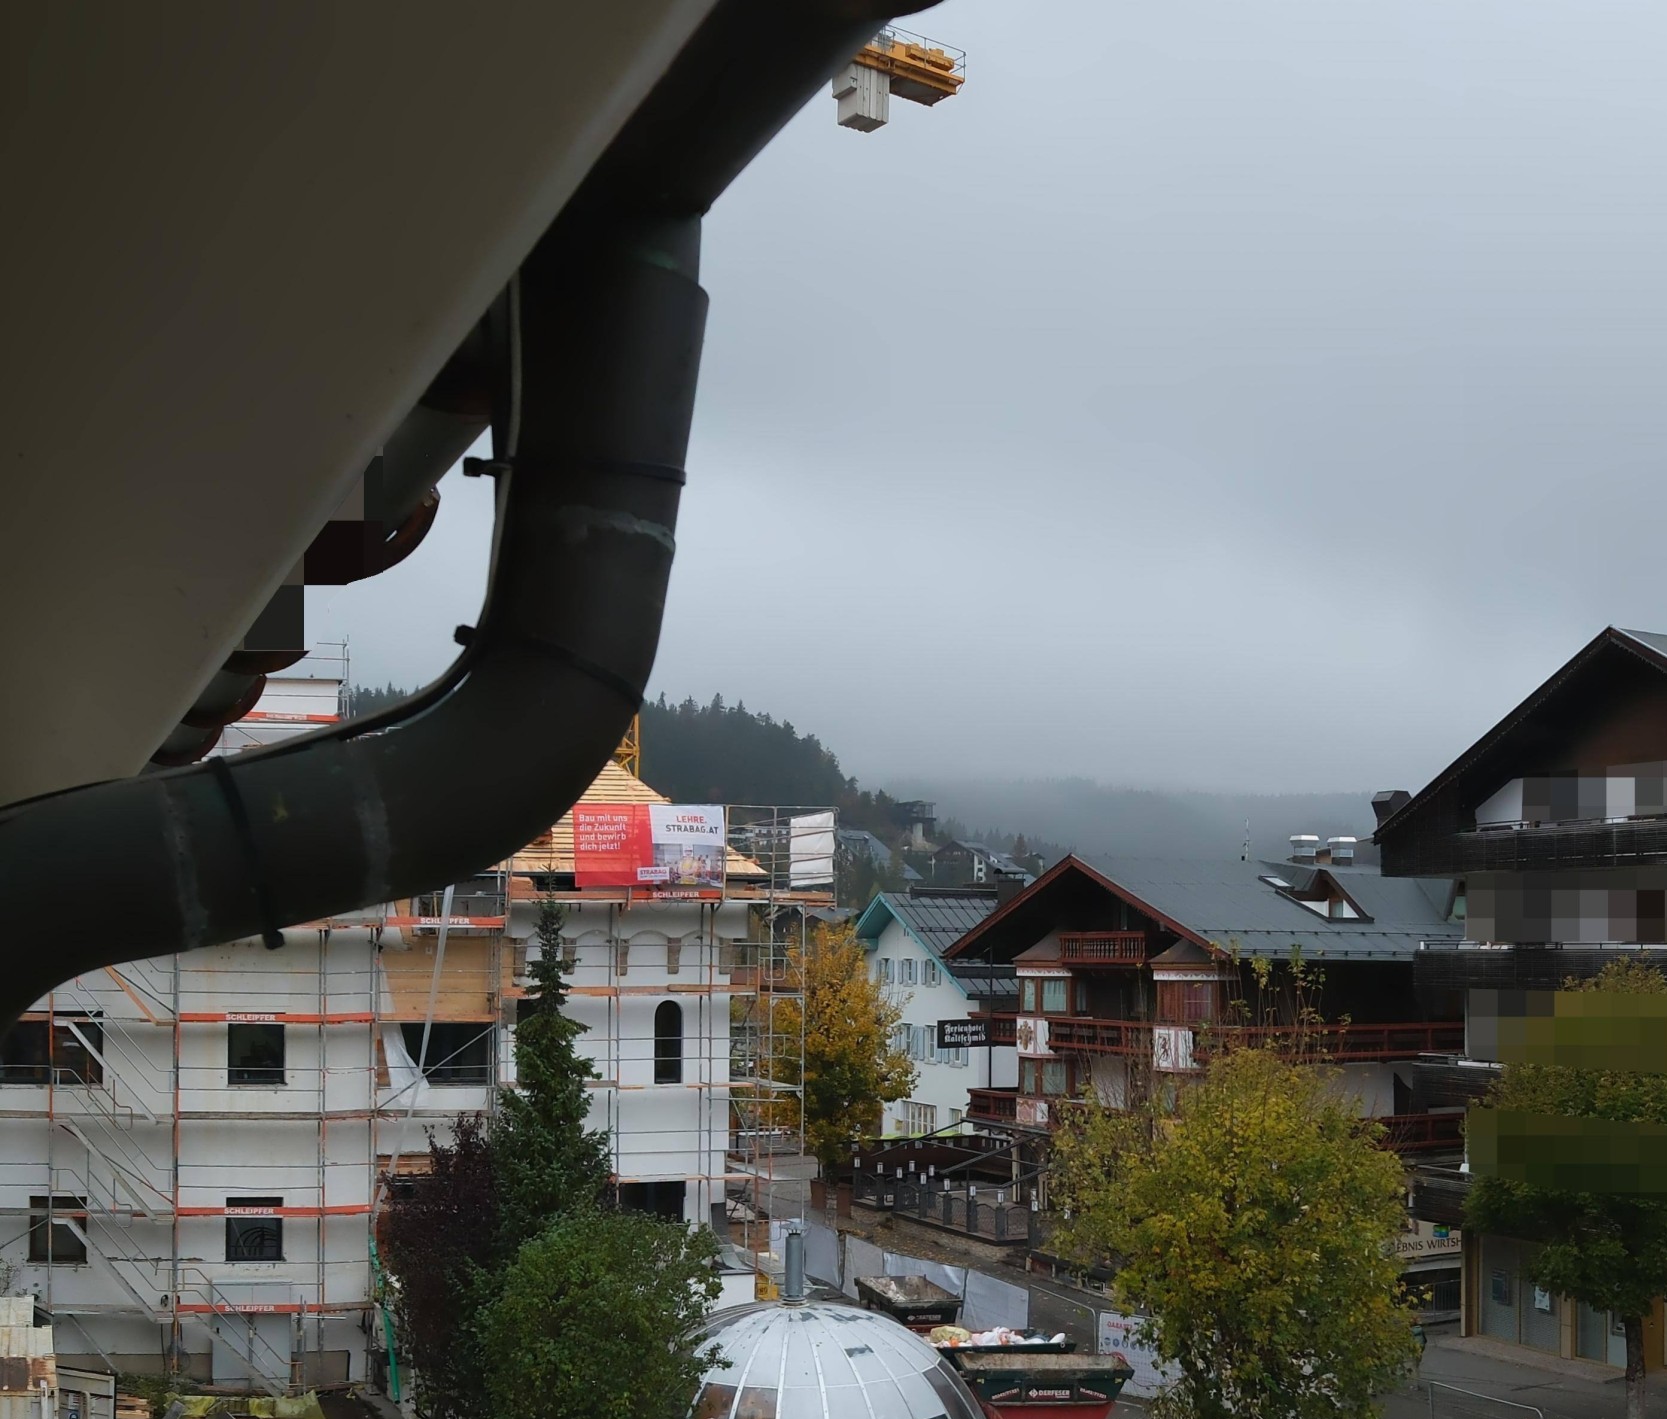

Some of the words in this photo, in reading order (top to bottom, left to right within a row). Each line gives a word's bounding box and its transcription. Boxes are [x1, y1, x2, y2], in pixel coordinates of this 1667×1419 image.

[579, 814, 596, 822] Bau
[597, 814, 611, 822] mit
[676, 815, 708, 824] LEHRE.
[665, 824, 719, 835] STRABAG.AT
[580, 833, 596, 841] und
[597, 833, 627, 841] bewirb
[599, 843, 621, 851] jetzt!
